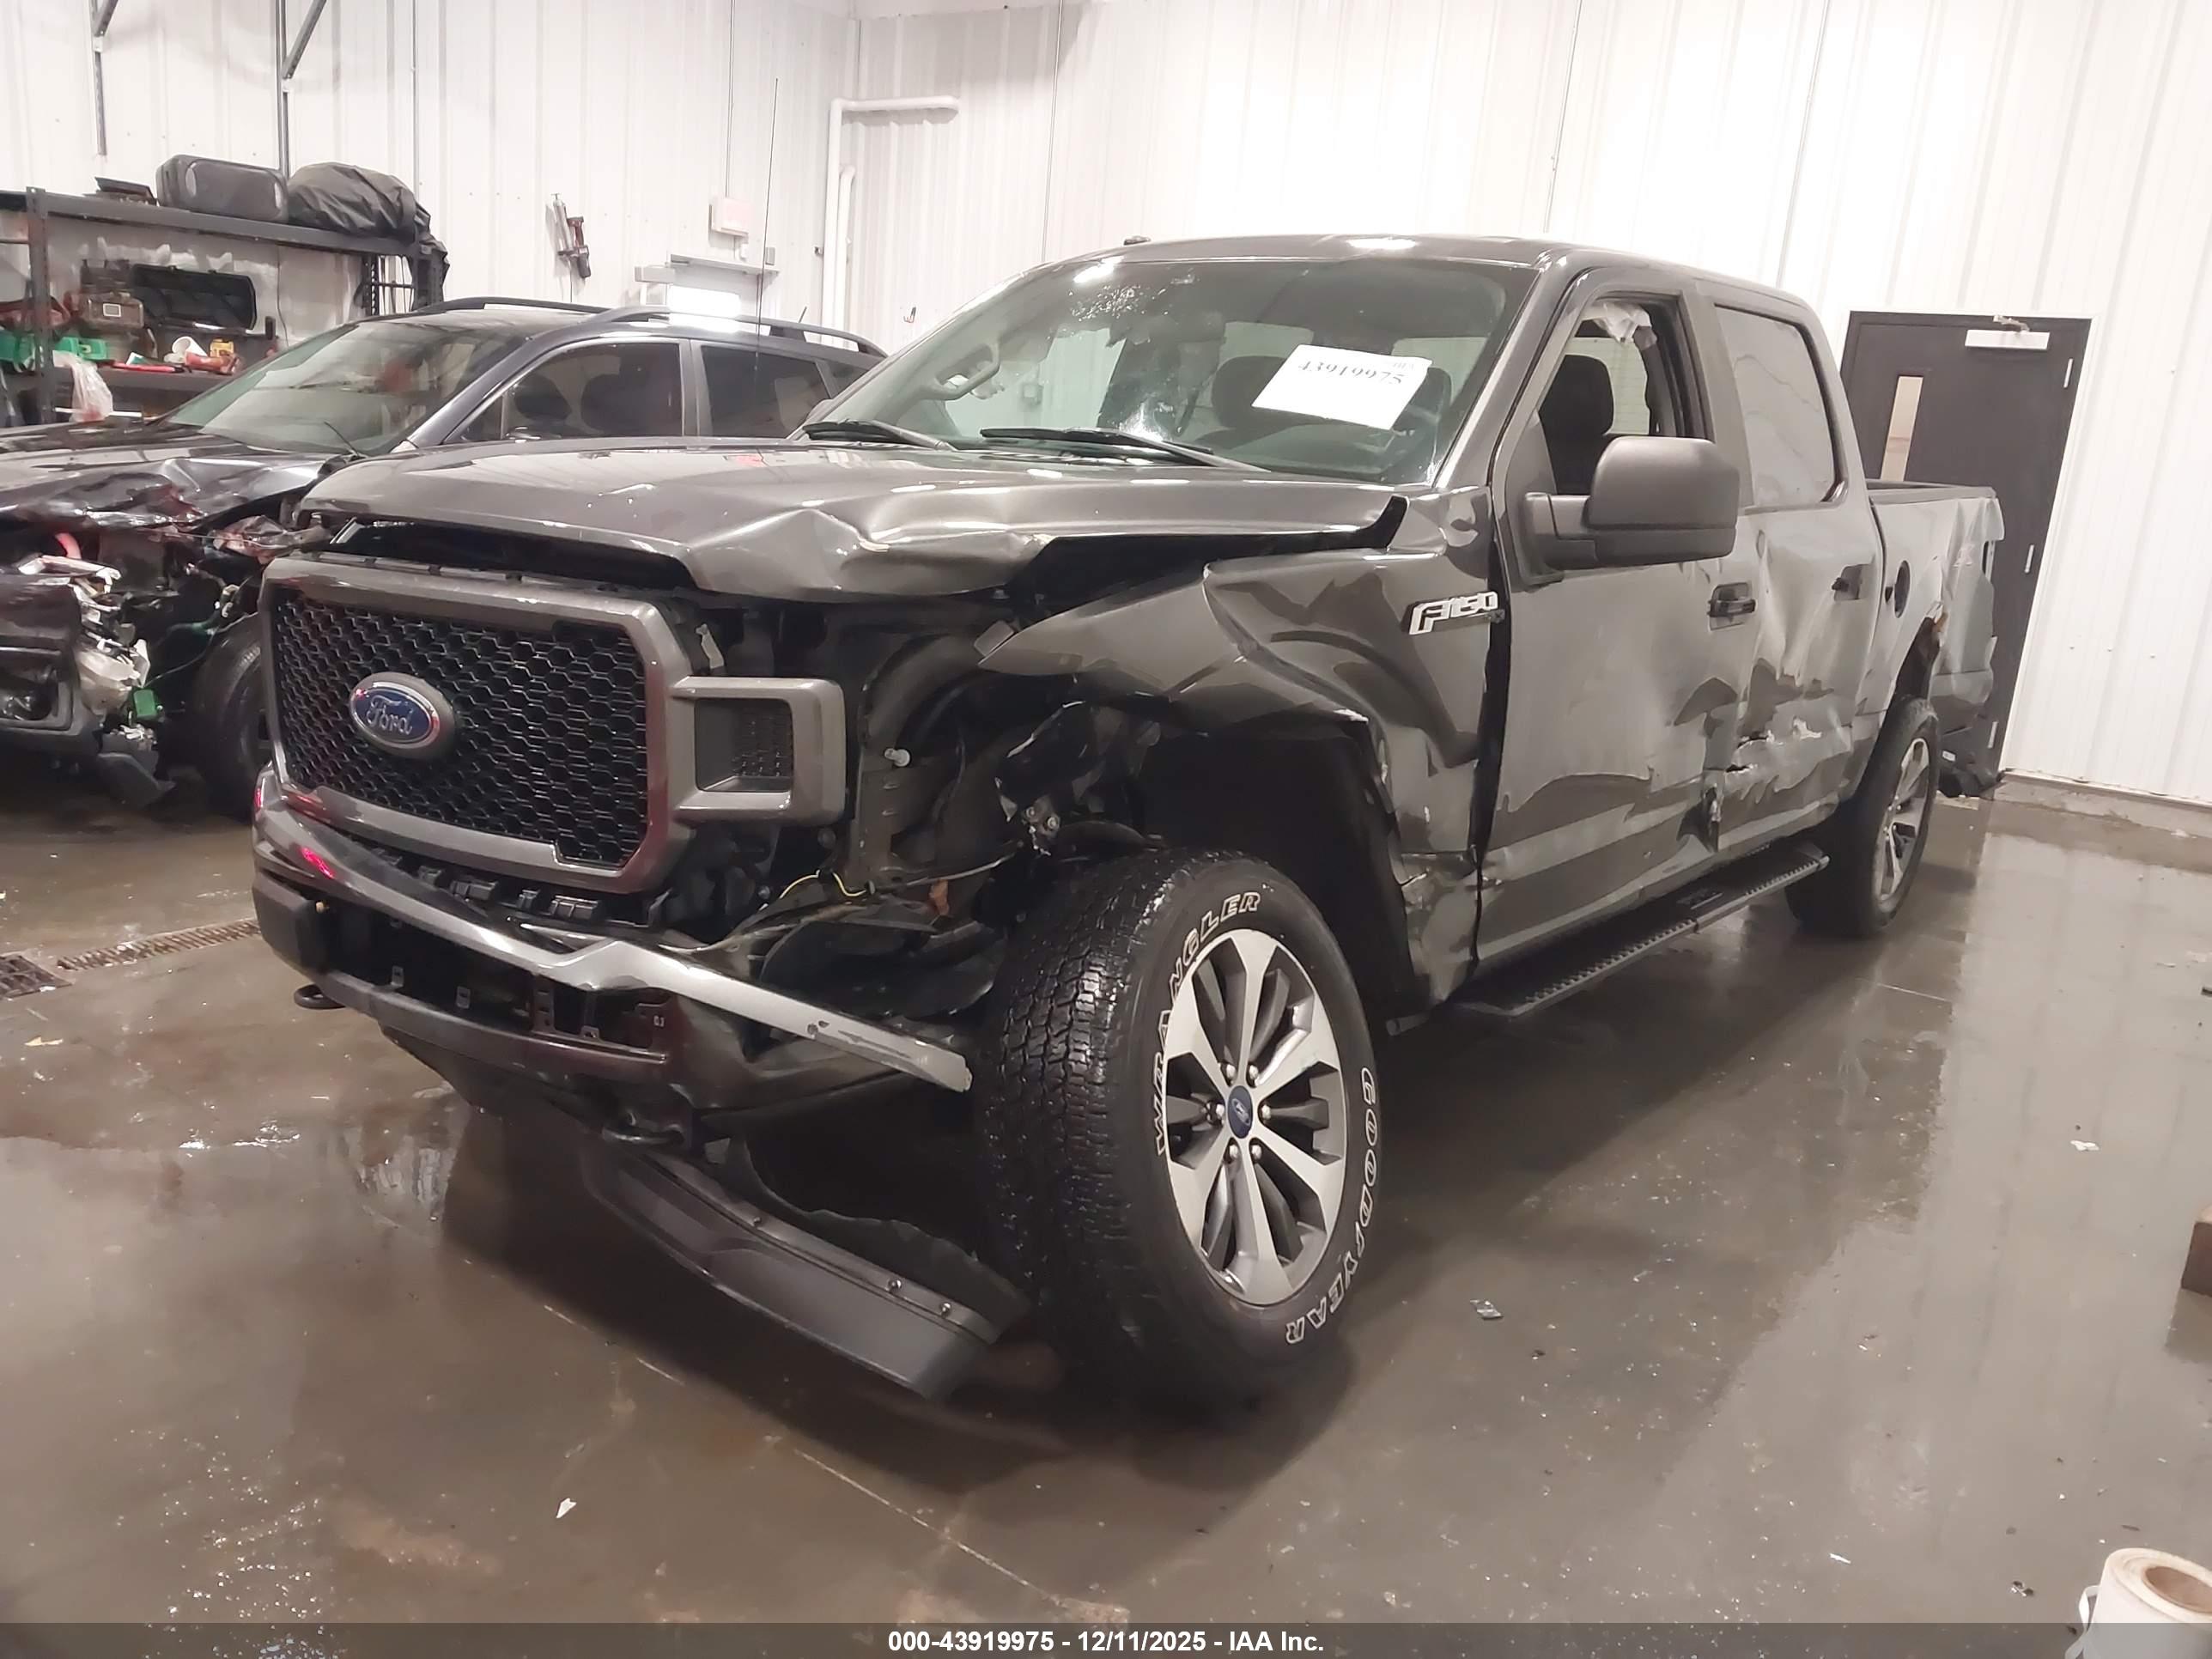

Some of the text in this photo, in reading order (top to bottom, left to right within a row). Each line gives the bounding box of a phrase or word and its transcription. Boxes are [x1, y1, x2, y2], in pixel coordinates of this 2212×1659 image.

[1297, 361, 1406, 385] 43919975
[366, 694, 414, 735] Ford
[1285, 1067, 1377, 1344] GOODYEAR
